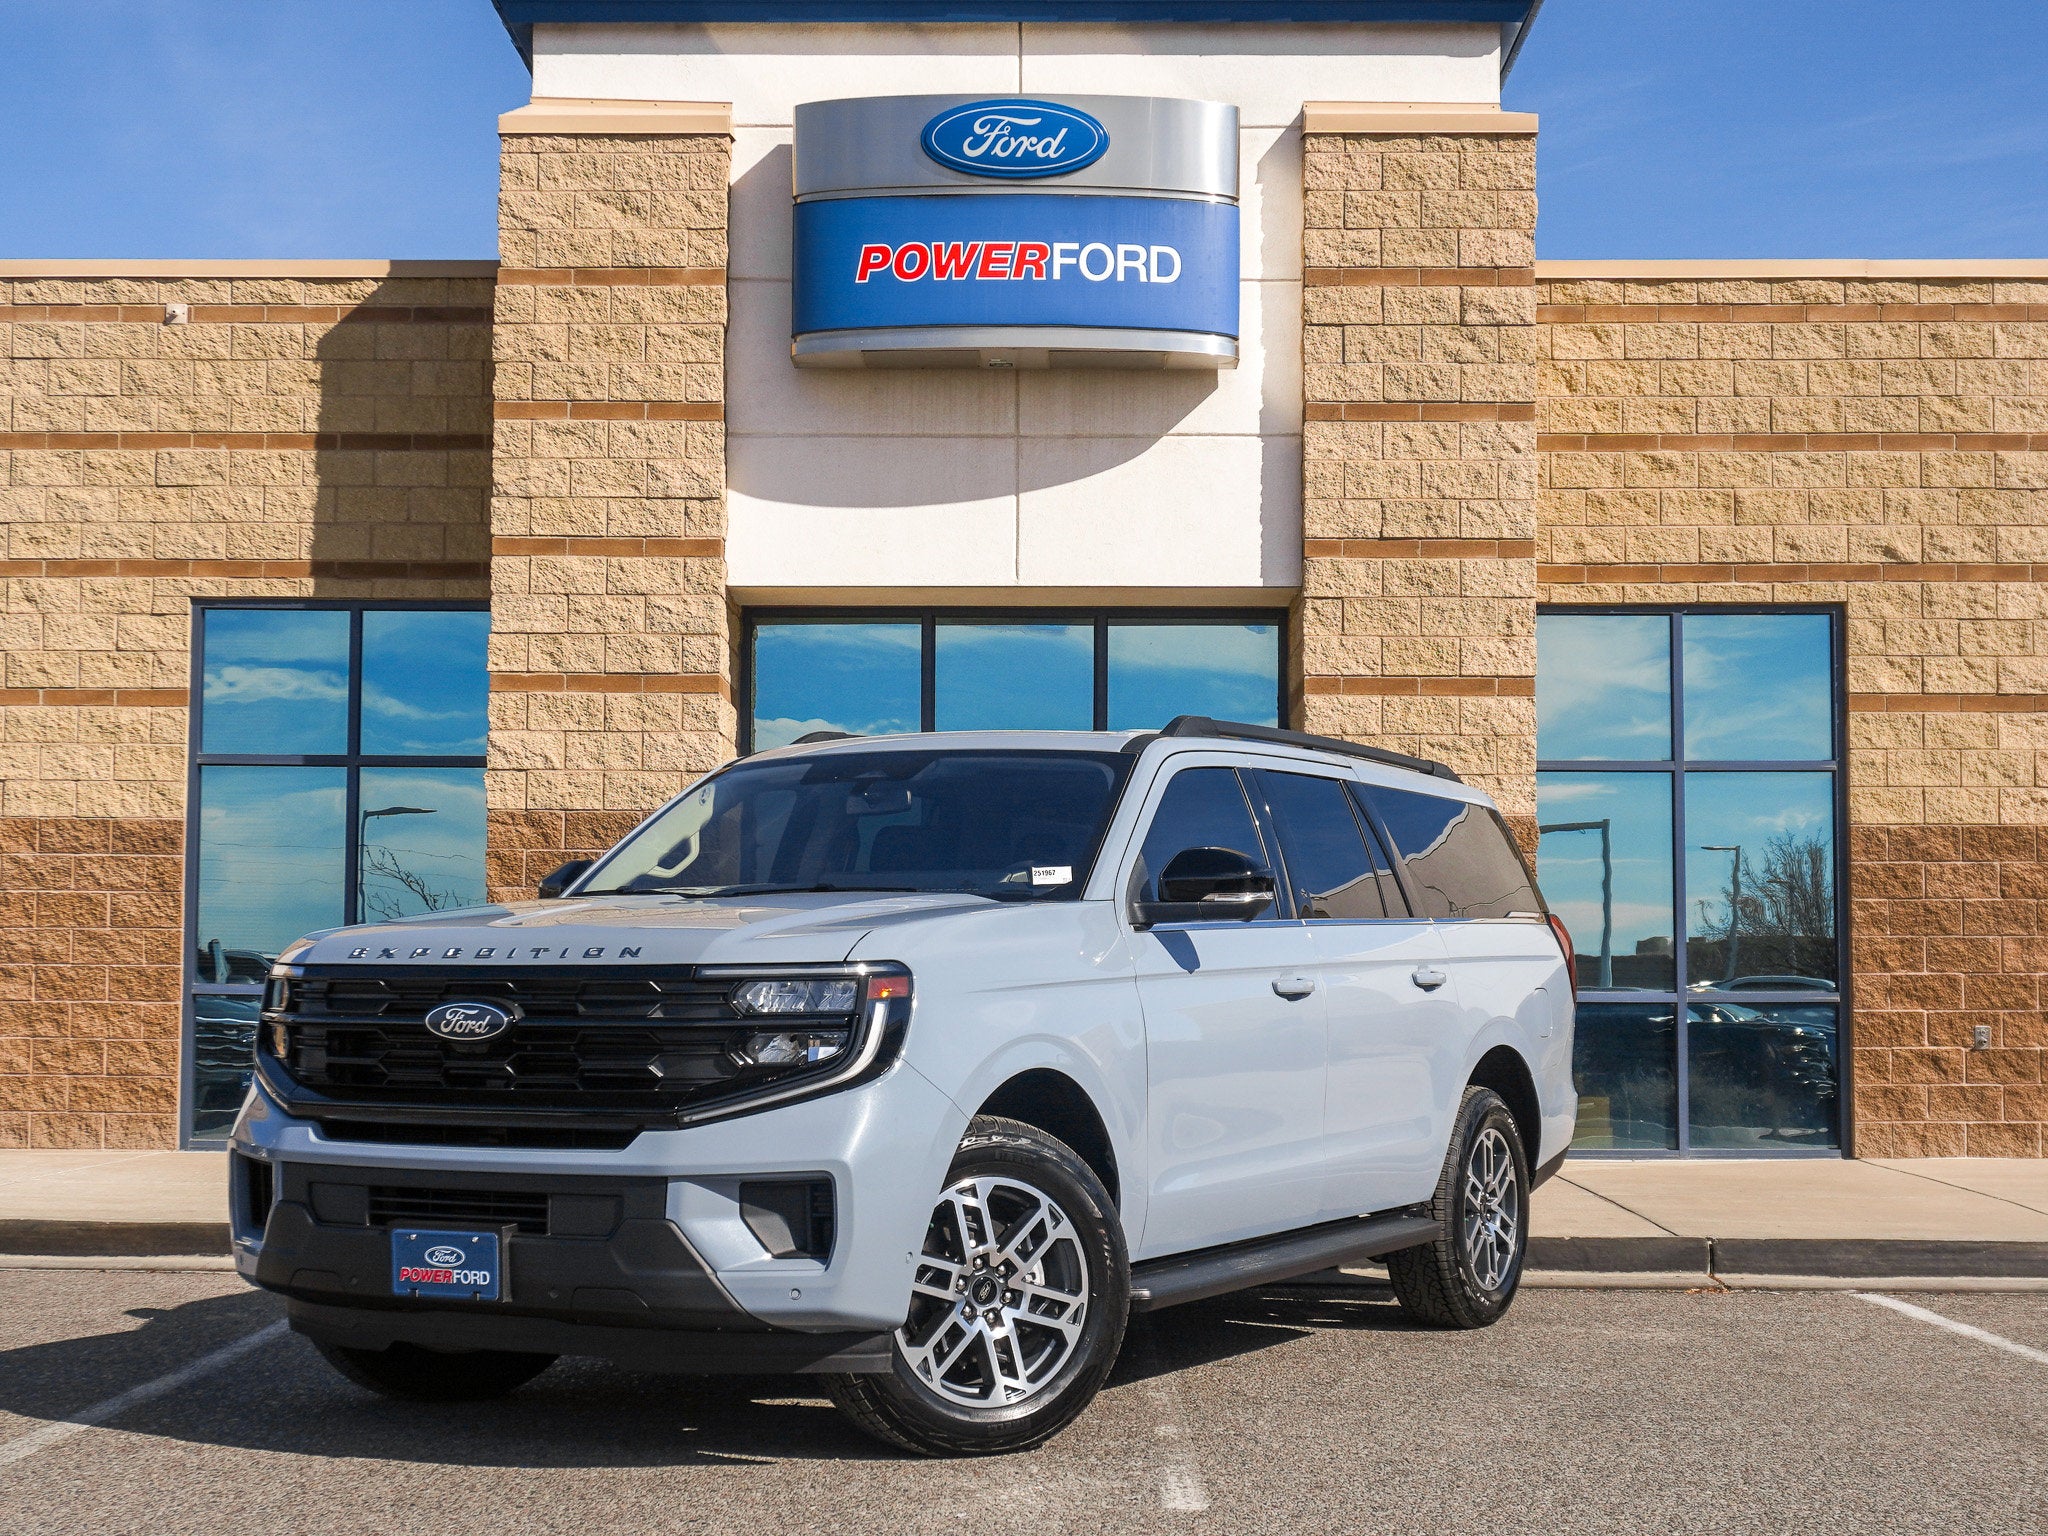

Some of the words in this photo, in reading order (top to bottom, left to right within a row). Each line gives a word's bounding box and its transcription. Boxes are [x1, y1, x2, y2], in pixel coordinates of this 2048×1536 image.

[962, 114, 1069, 159] Ford
[854, 241, 1183, 284] POWERFORD
[347, 947, 643, 959] EXPEDITION
[440, 1007, 492, 1034] Ford
[432, 1249, 457, 1263] Ford
[399, 1266, 490, 1285] POWERFORD
